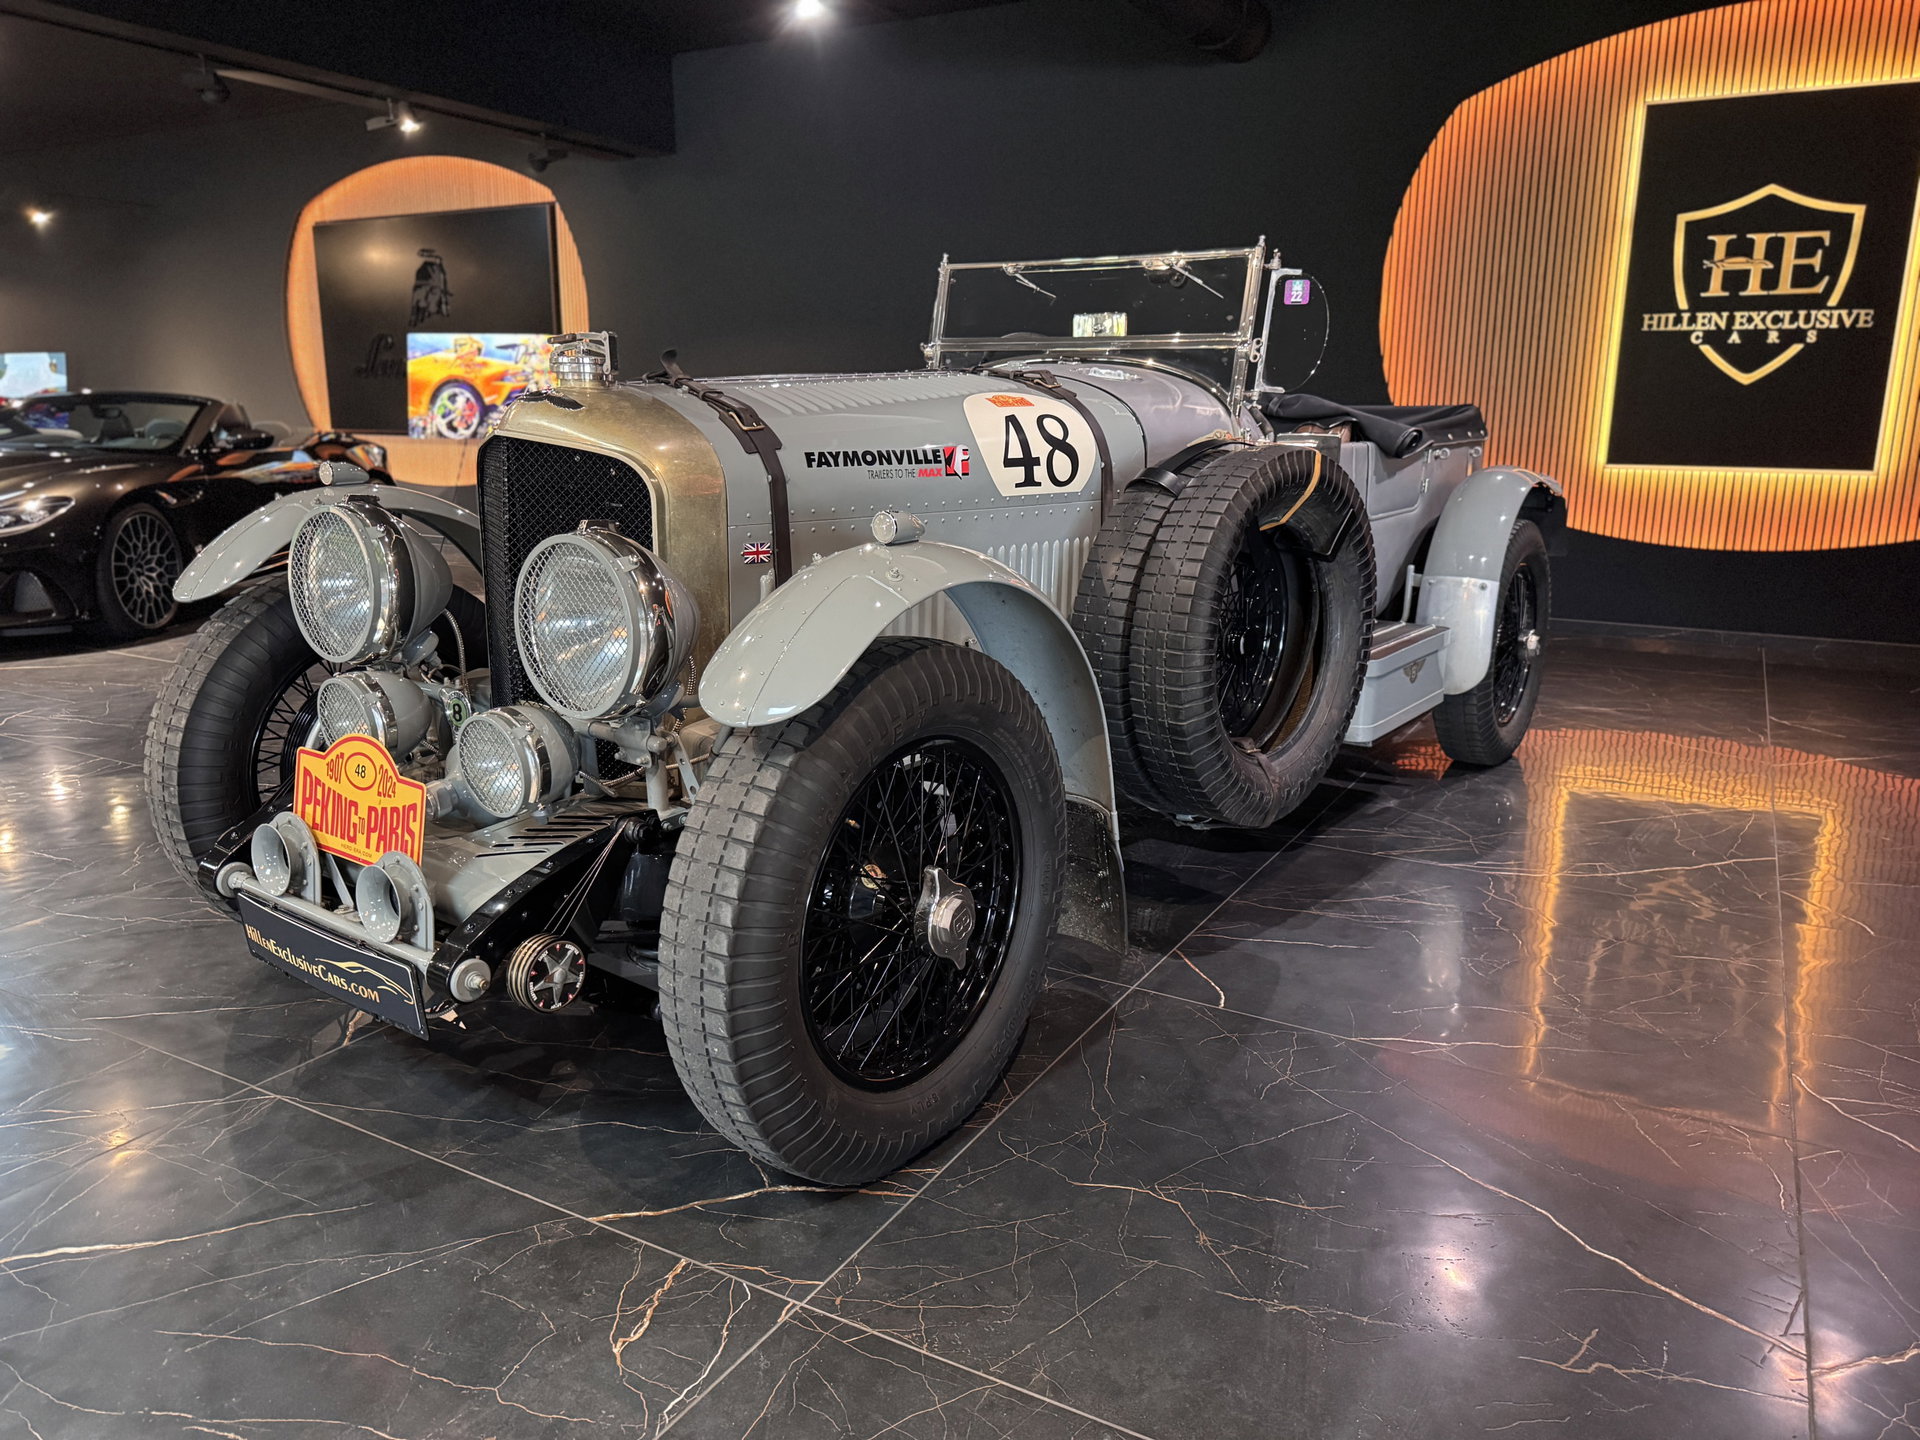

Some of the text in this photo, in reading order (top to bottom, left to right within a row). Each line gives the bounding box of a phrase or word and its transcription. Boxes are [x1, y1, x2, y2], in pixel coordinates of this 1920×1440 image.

[1700, 230, 1830, 297] HE
[1291, 291, 1303, 302] 22
[1642, 309, 1874, 331] HILLEN EXCLUSIVE
[1690, 330, 1817, 344] CARS
[804, 449, 942, 468] FAYMONVILLE
[1002, 414, 1080, 488] 48
[868, 468, 943, 480] TRAILERS TO THE MAX
[326, 752, 344, 784] 1907
[355, 764, 366, 778] 48
[377, 764, 396, 798] 2024
[301, 766, 417, 860] PEKING TO PARIS
